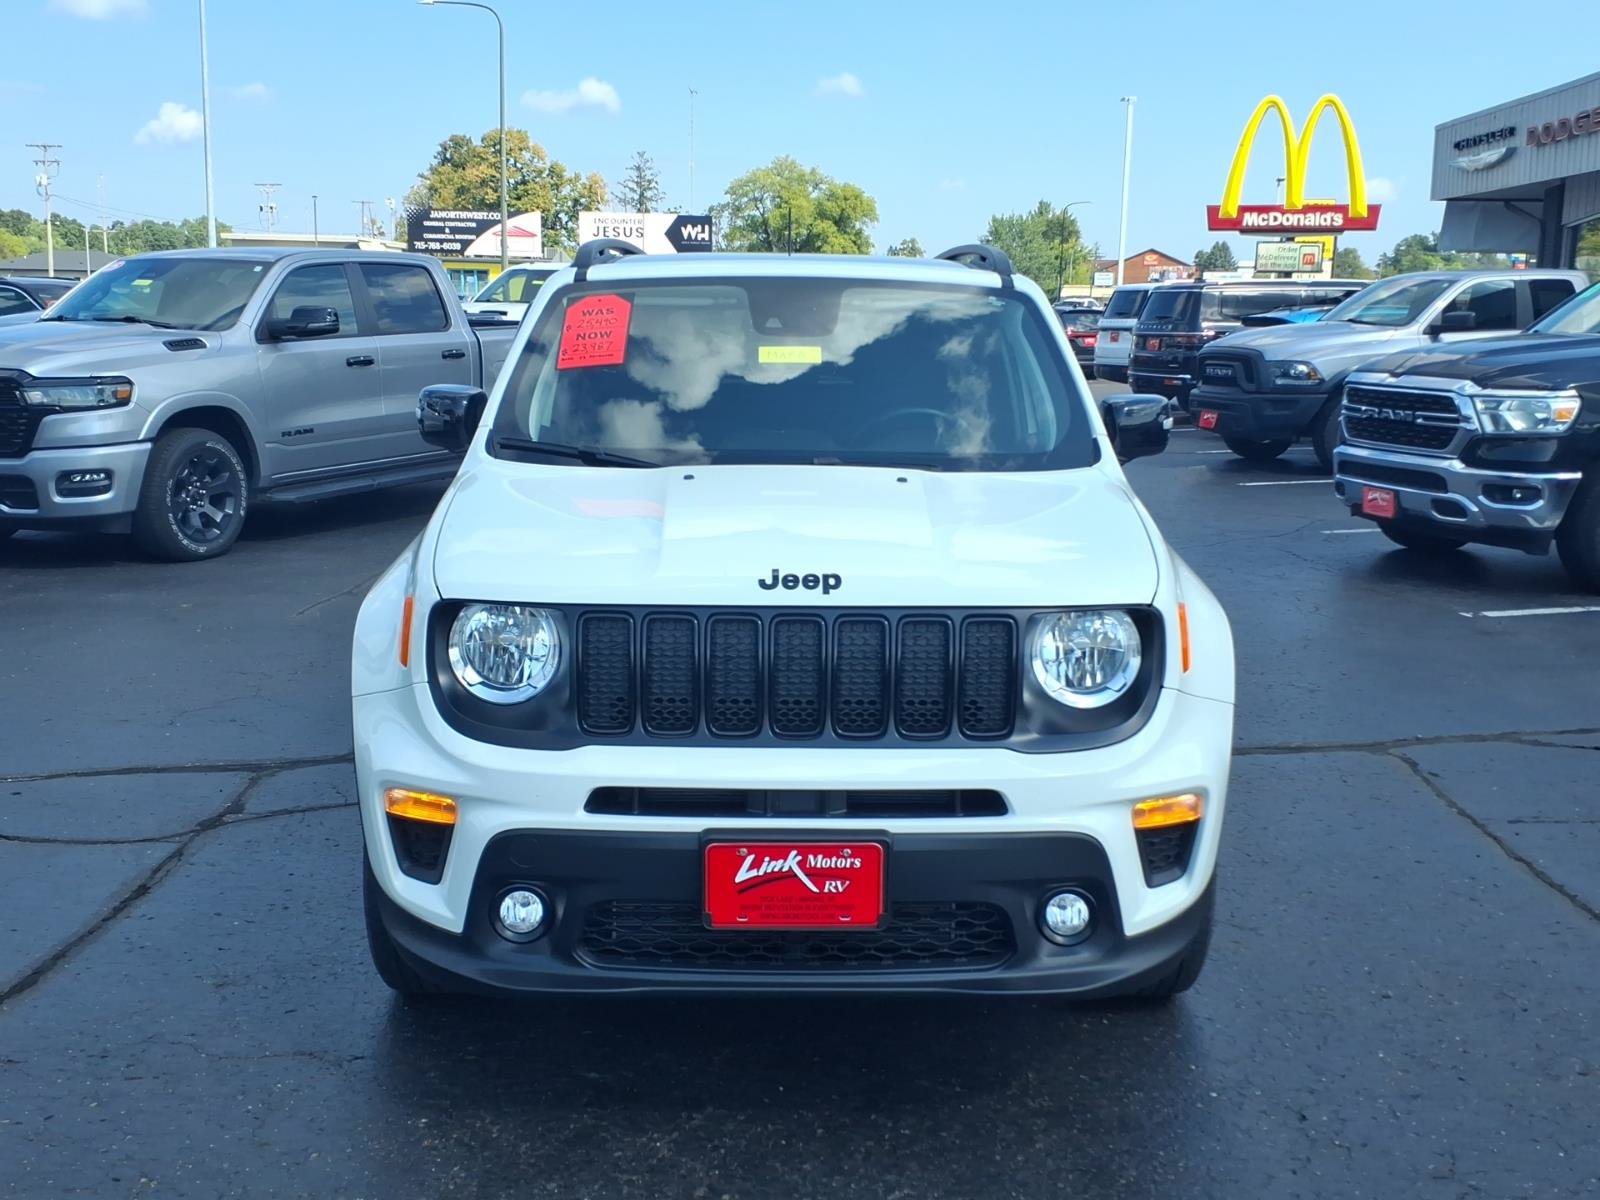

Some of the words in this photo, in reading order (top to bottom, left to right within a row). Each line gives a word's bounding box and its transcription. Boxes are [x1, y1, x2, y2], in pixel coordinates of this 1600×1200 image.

[429, 210, 501, 220] JANORTHWEST.CO
[1241, 211, 1344, 227] McDonald's
[593, 217, 643, 225] ENCOUNTER
[592, 226, 644, 238] JESUS
[581, 307, 615, 317] WAS
[575, 330, 613, 341] NOW
[281, 427, 314, 438] RAM
[758, 568, 842, 595] Jeep
[734, 849, 820, 894] Link
[806, 853, 862, 869] Motors
[822, 880, 850, 893] RV
